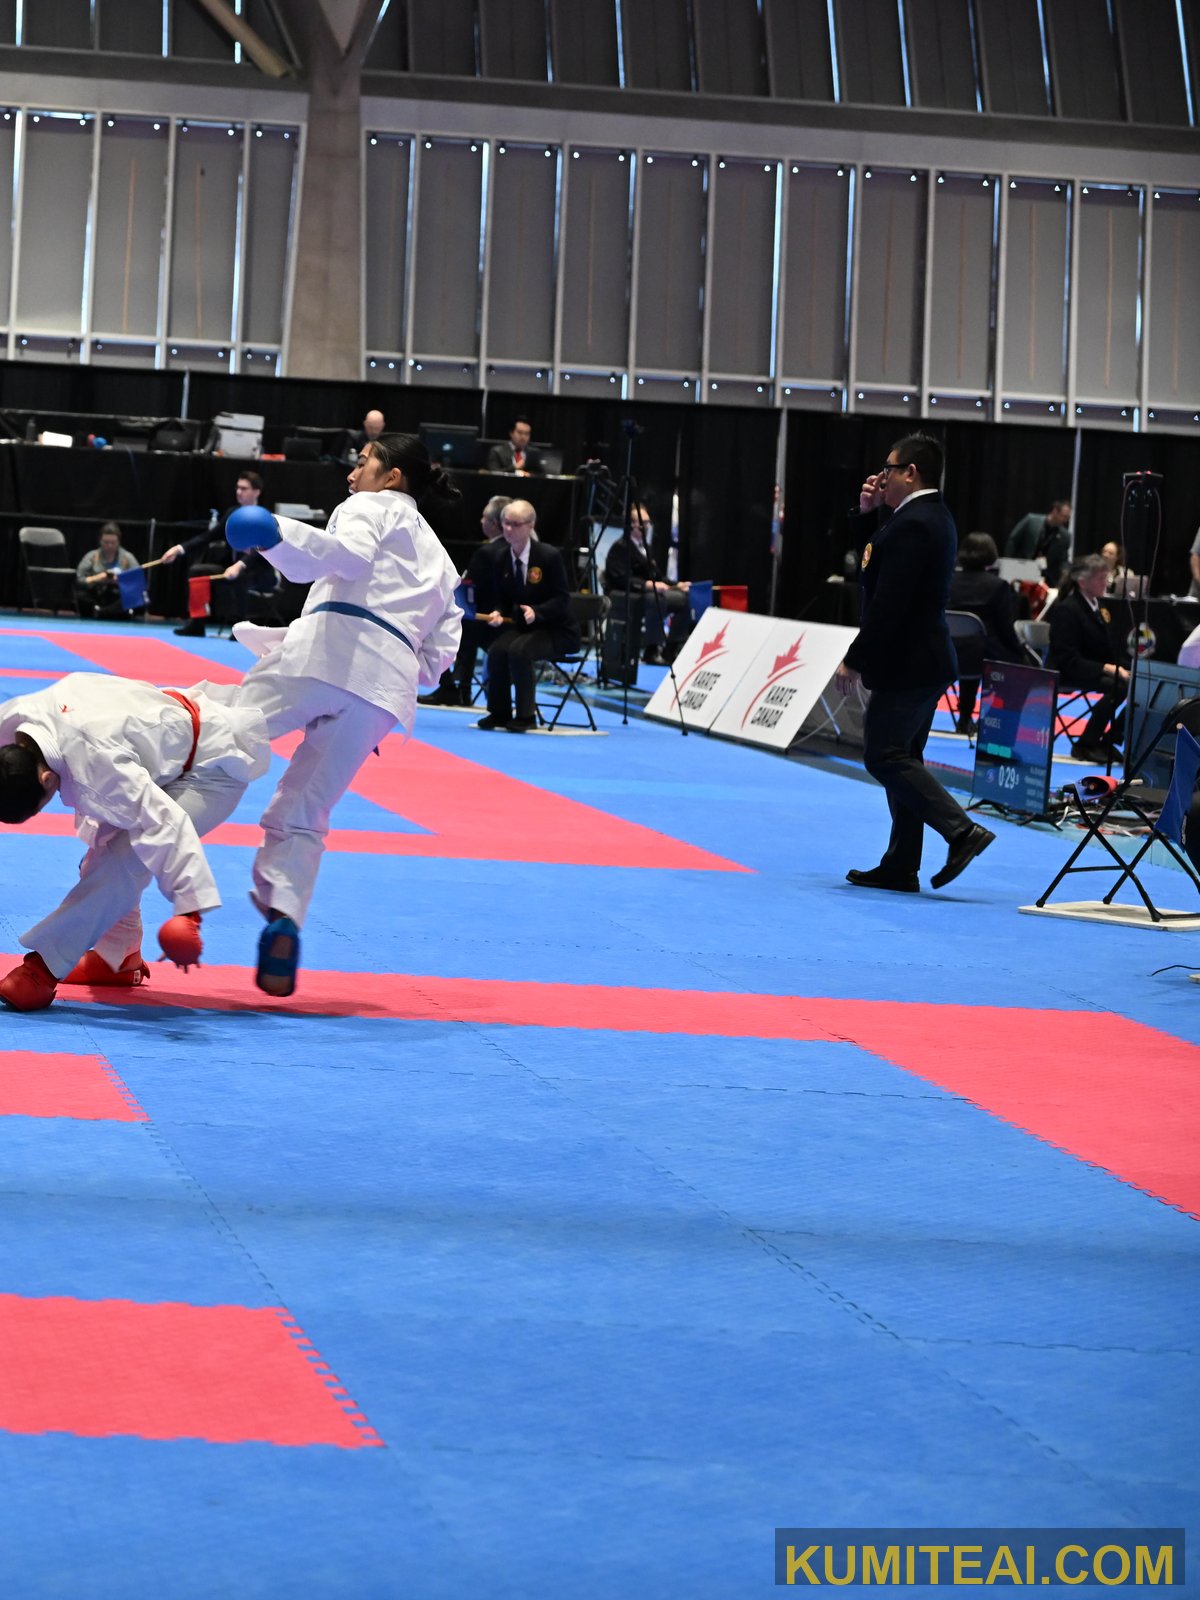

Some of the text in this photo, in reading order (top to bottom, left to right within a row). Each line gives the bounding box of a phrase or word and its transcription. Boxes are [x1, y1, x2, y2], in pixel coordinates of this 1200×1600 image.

[693, 671, 721, 690] KARATE
[681, 690, 708, 710] CANADA
[765, 686, 797, 707] KARATE
[751, 707, 783, 728] CANADA
